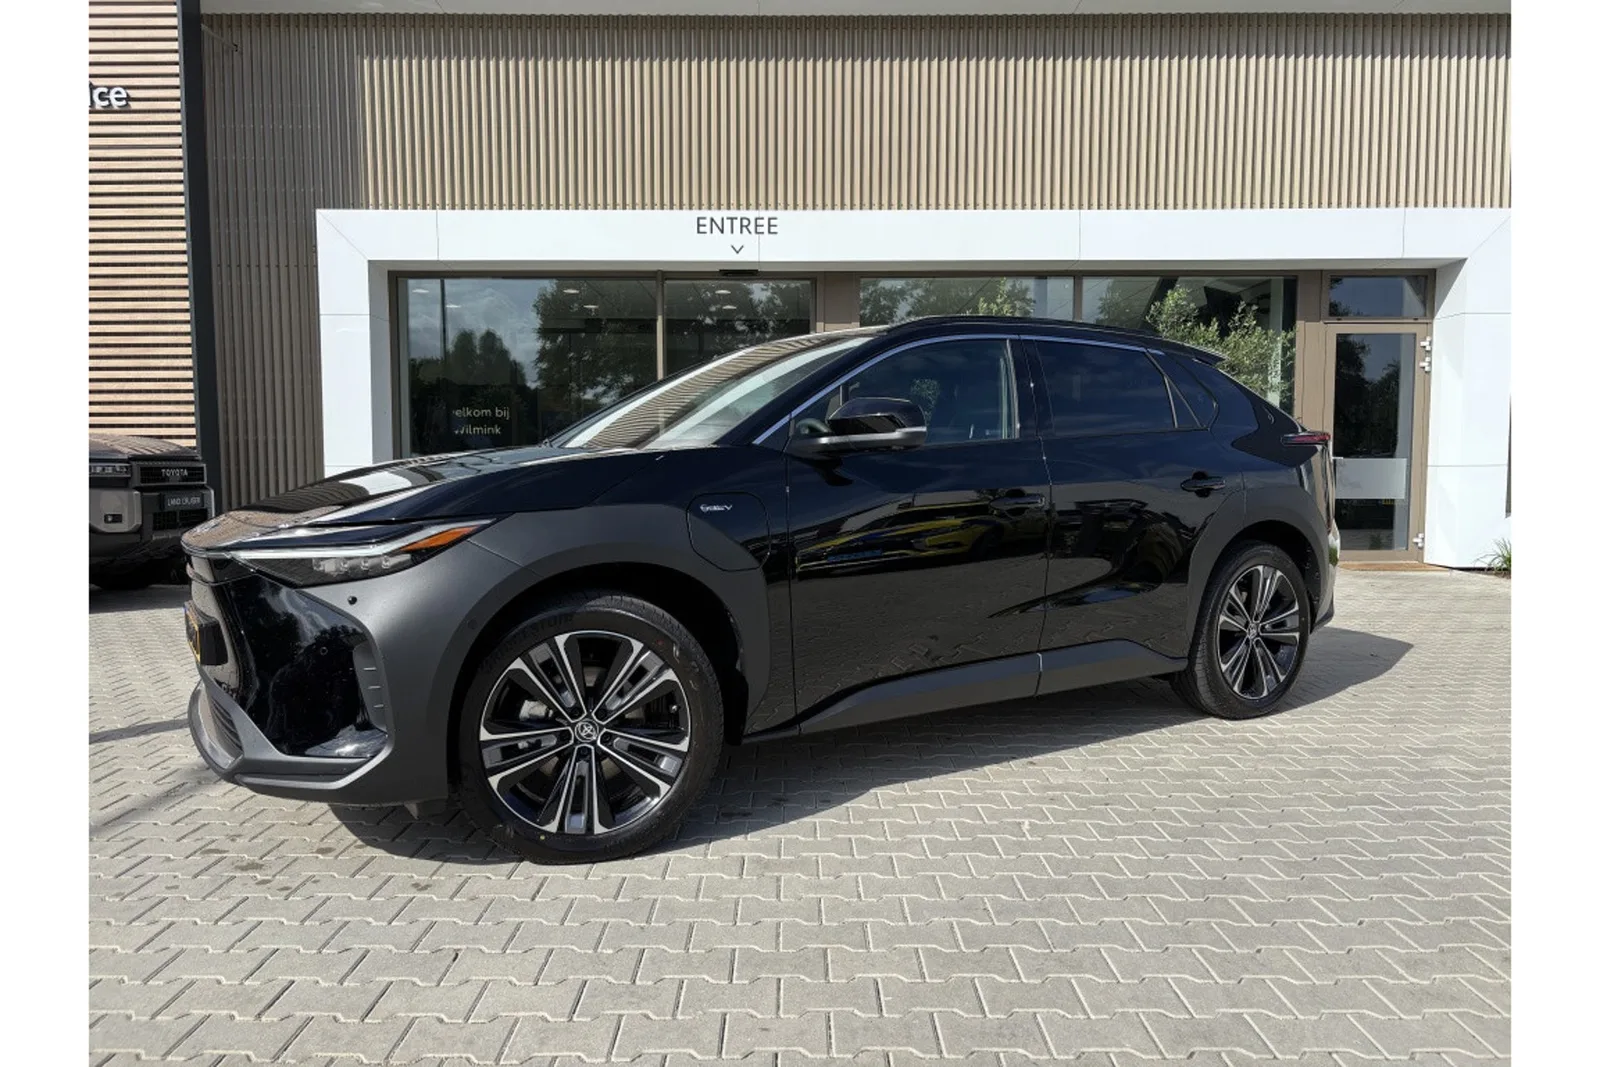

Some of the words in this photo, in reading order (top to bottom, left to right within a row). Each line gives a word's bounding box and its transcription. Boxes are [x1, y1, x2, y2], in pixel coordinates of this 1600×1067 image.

[89, 86, 129, 108] ce
[696, 216, 779, 235] ENTREE
[452, 406, 492, 418] elkom
[495, 406, 510, 420] bij
[161, 468, 188, 477] TOYOTA
